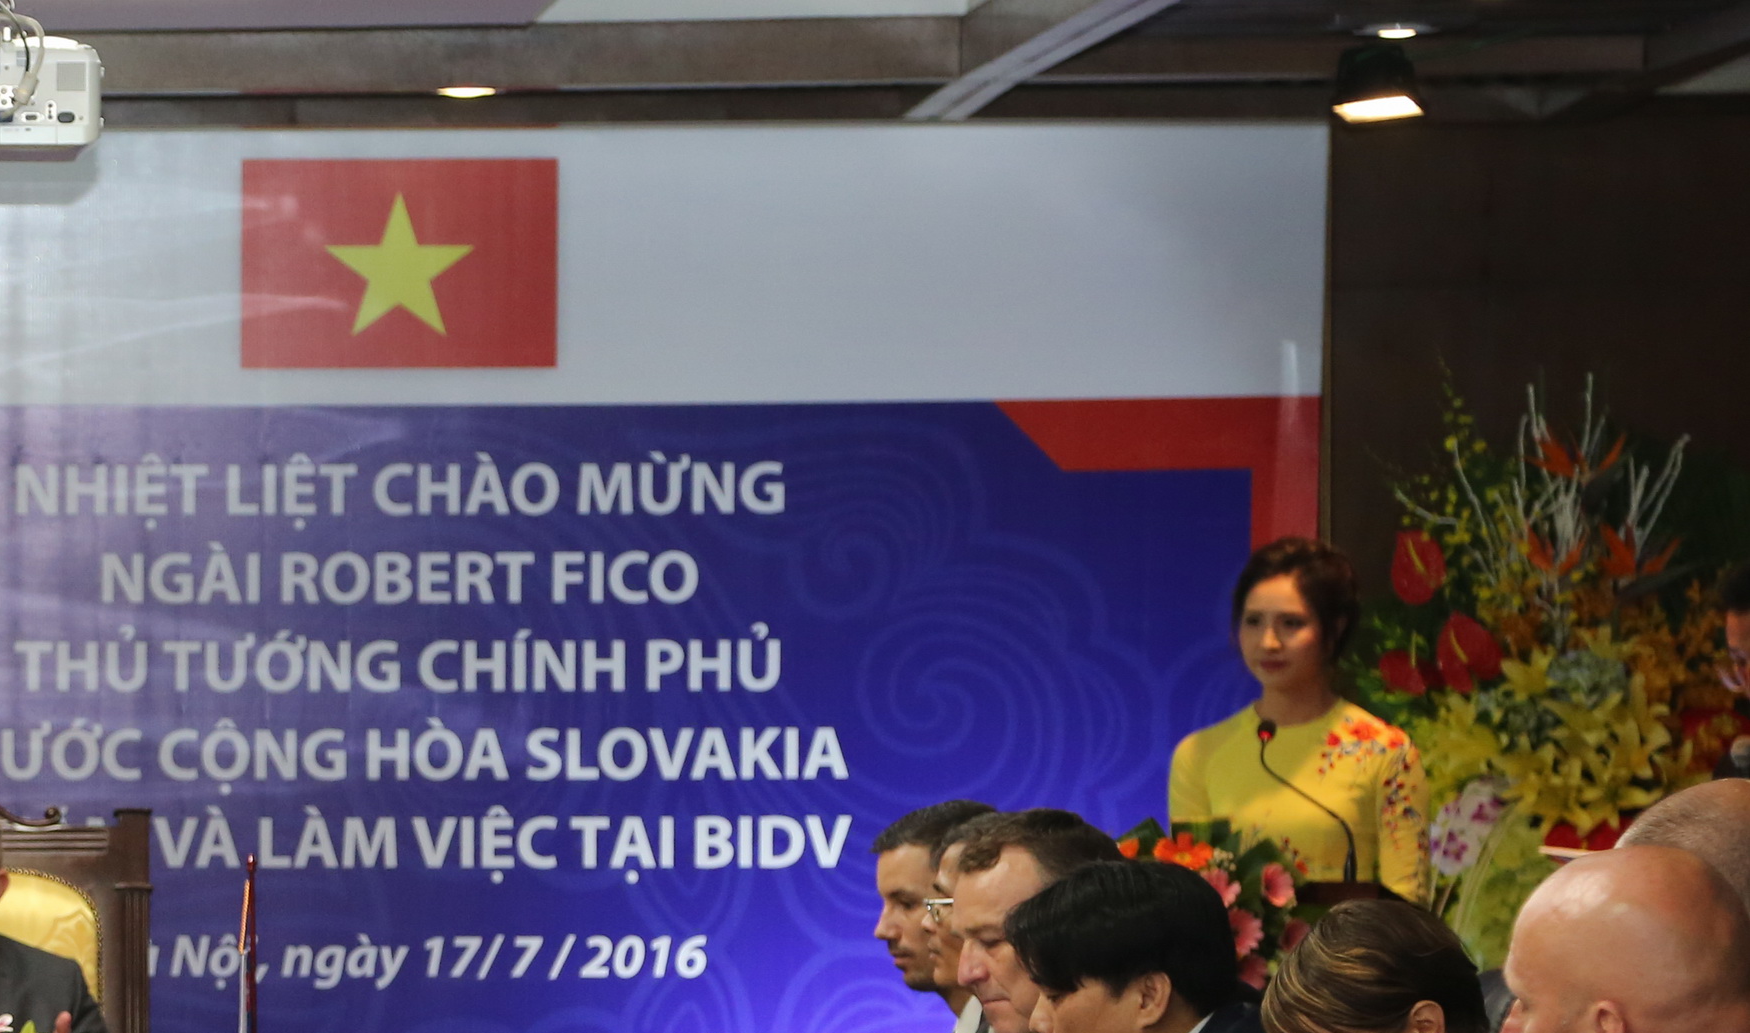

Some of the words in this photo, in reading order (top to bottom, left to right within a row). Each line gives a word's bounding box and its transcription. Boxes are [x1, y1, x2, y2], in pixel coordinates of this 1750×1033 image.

[13, 452, 210, 530] NHIỆT
[225, 452, 358, 530] LIỆT
[374, 452, 560, 517] CHÀO
[576, 451, 786, 517] MỪNG
[101, 540, 262, 605] NGÀI
[280, 551, 536, 605] ROBERT
[551, 549, 700, 605] FICO
[12, 624, 148, 693] THỦ
[161, 629, 401, 694] TƯỚNG
[418, 628, 626, 694] CHÍNH
[645, 621, 783, 693] PHỦ
[157, 717, 347, 796] CỘNG
[366, 716, 510, 781] HÒA
[524, 725, 850, 782] SLOVAKIA
[153, 805, 241, 869] VÀ
[258, 805, 398, 869] LÀM
[411, 804, 559, 884] VIỆC
[568, 814, 675, 884] TẠI
[693, 814, 853, 870] BIDV
[280, 932, 410, 991] ngày
